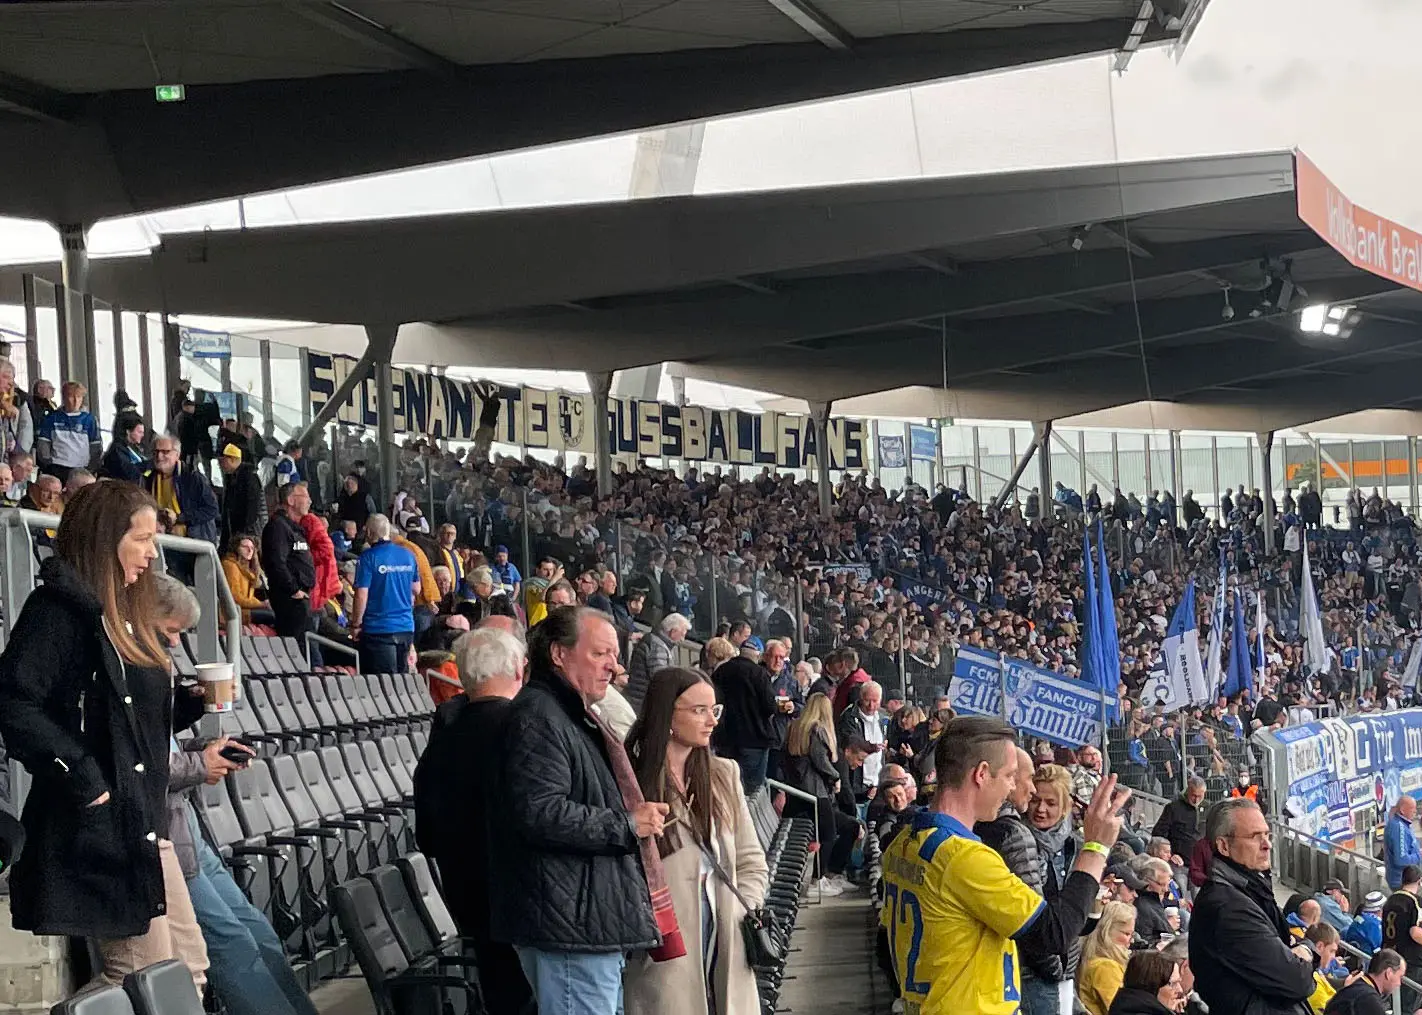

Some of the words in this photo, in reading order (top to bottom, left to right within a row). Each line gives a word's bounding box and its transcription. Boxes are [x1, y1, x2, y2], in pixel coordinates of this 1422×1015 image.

[1326, 187, 1387, 271] Volksbank
[968, 665, 1000, 684] FCM
[1036, 685, 1097, 716] FANCLUB
